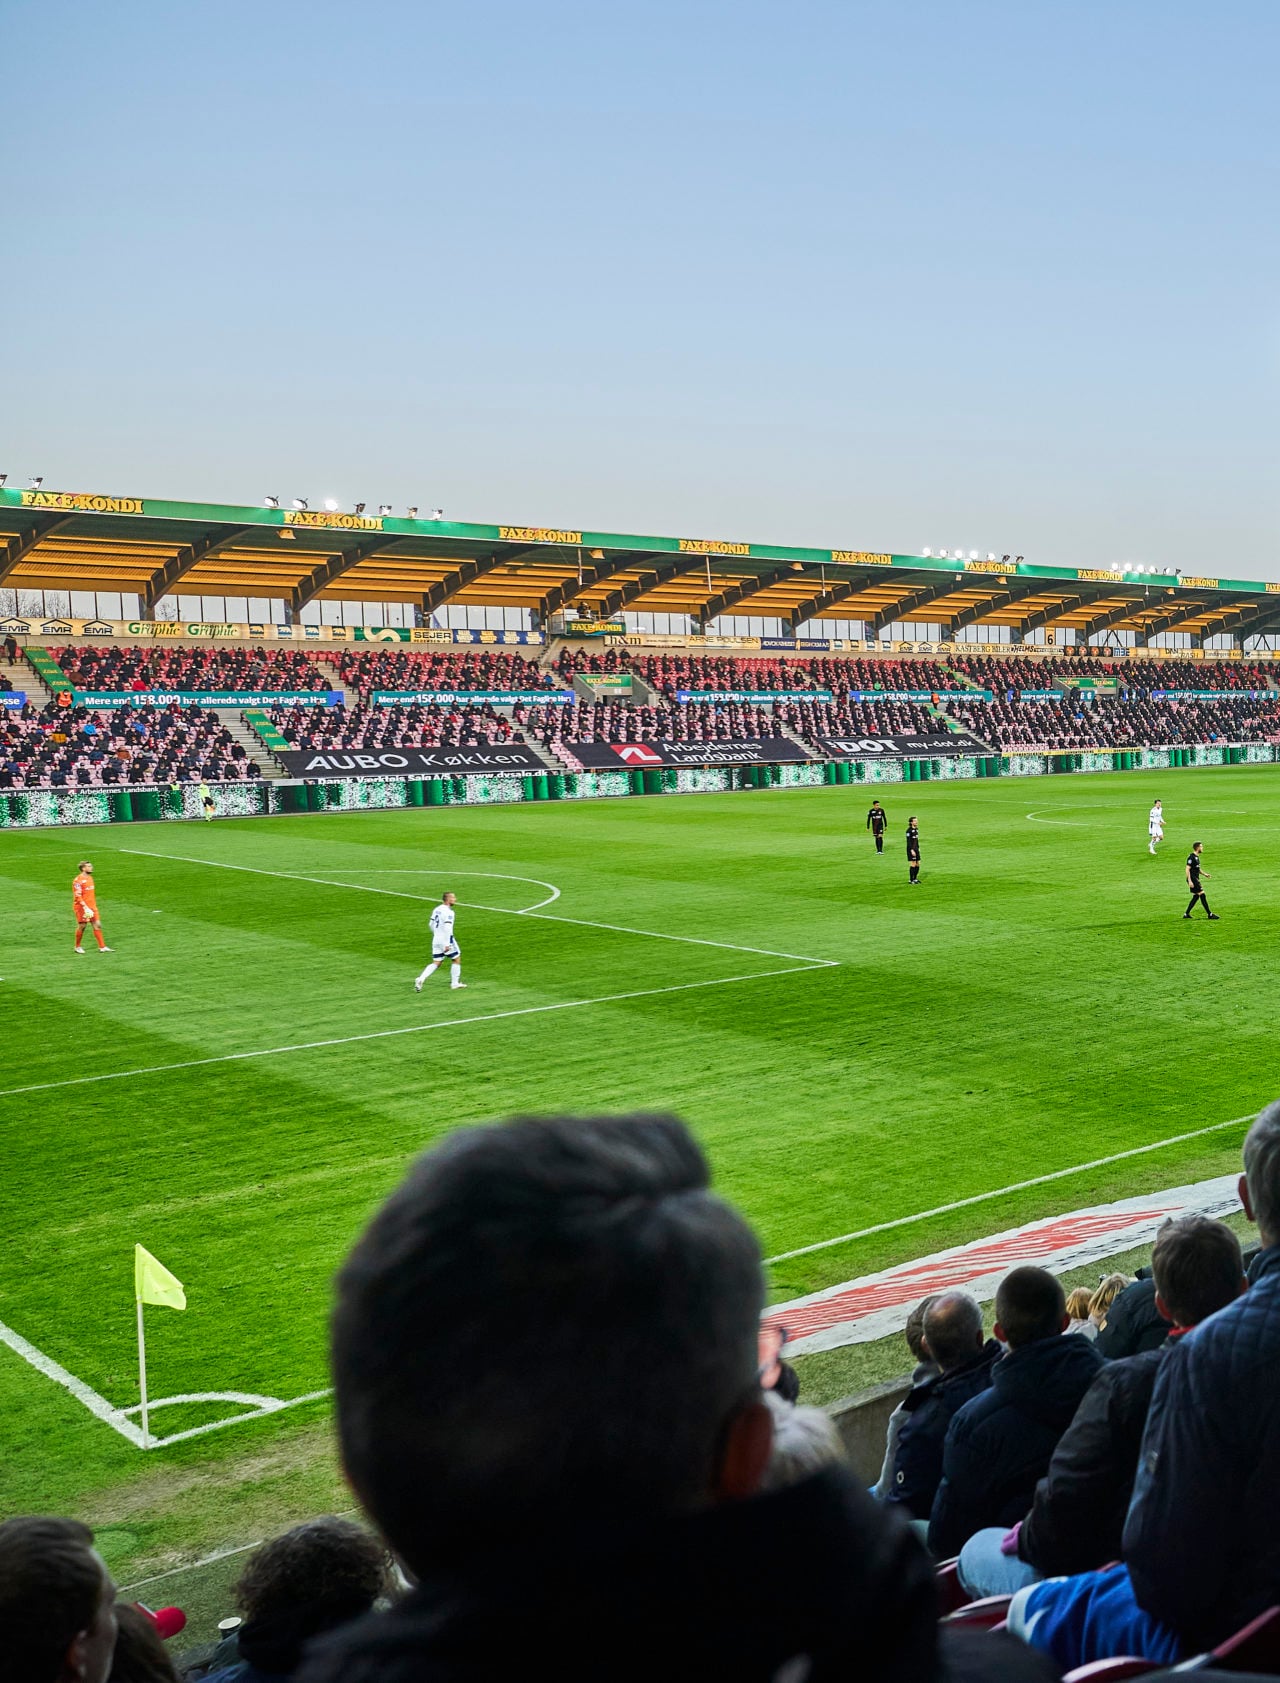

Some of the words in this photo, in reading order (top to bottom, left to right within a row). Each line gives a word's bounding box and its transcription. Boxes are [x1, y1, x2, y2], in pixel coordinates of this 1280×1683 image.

[22, 491, 75, 509] FAXE
[78, 496, 145, 514] KONDI
[284, 511, 326, 526] FAXE
[327, 514, 384, 531] KONDI
[498, 527, 534, 541] FAXE
[535, 530, 583, 544] KONDI
[679, 540, 711, 552] FAXE
[711, 542, 750, 555] KONDI
[832, 551, 859, 563] FAXE
[859, 552, 893, 565] KONDI
[964, 562, 988, 572] FAXE
[988, 563, 1017, 575] KONDI
[1078, 570, 1098, 579] FAXE
[1098, 571, 1124, 582] KONDI
[42, 626, 72, 634] EMR
[571, 622, 595, 633] FAXE
[596, 623, 622, 633] KONDI
[717, 636, 759, 644] POULSEN
[1048, 634, 1054, 645] 6
[956, 645, 991, 653] KASTBERG
[85, 697, 111, 705] Mere
[133, 695, 181, 705] 158.000
[201, 696, 238, 705] allerede
[239, 697, 261, 706] valgt
[279, 698, 309, 706] Faglige
[500, 696, 518, 704] valgt
[662, 742, 763, 753] Arbejdernes
[834, 740, 900, 753] DOT
[906, 740, 976, 750] my-dot.dk
[305, 754, 408, 770] AUBO
[419, 753, 529, 766] Køkken
[670, 750, 764, 763] Landsbank
[124, 786, 159, 794] Landsbank
